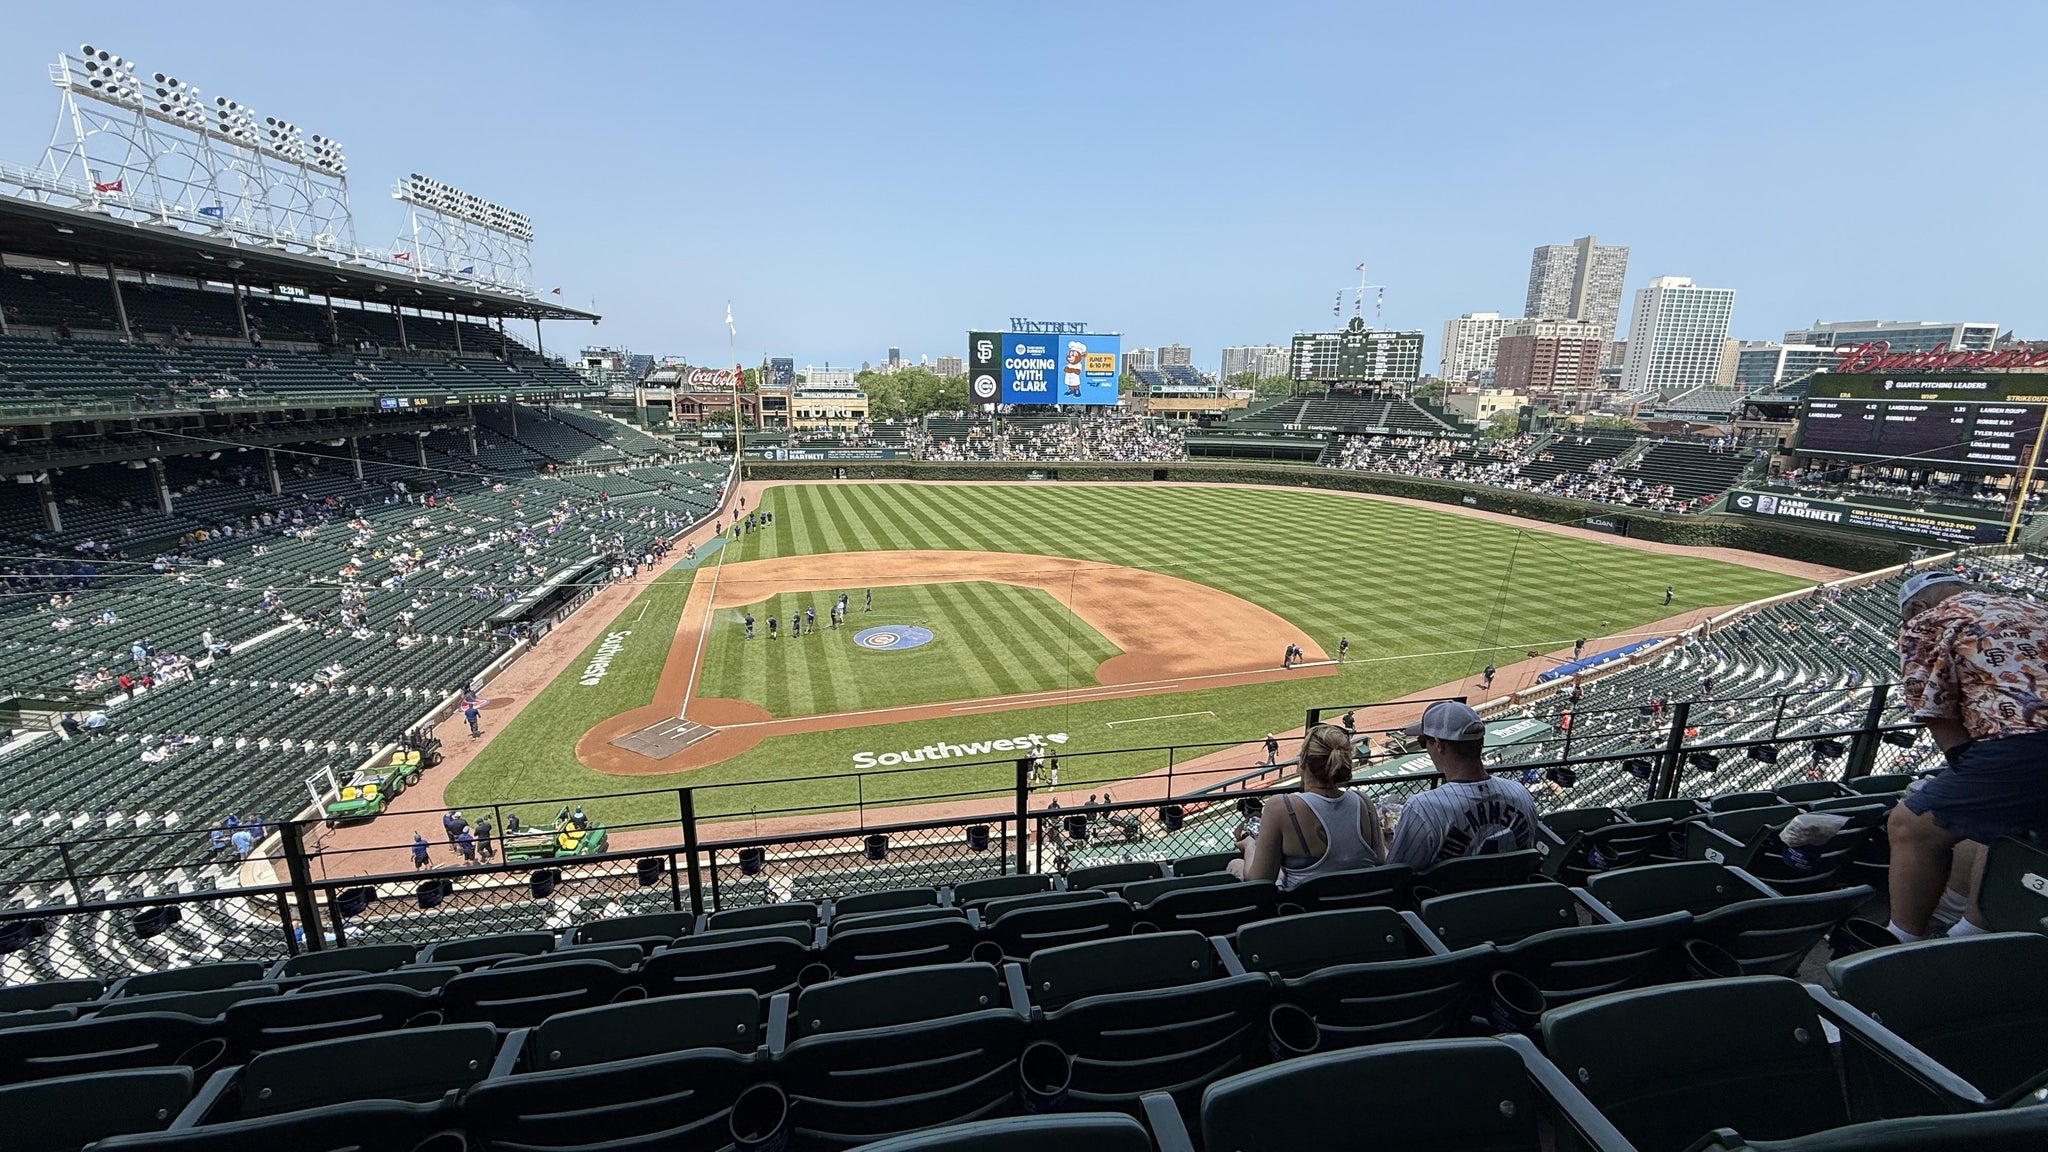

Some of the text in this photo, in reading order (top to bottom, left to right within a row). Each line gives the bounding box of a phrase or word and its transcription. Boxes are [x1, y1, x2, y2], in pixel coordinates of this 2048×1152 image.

[295, 287, 304, 297] PM
[1833, 340, 2048, 373] Budweise
[1005, 358, 1055, 369] COOKING
[688, 369, 738, 386] Coca-Cola
[1015, 370, 1043, 380] WITH
[1012, 380, 1047, 391] CLARK
[1921, 381, 1953, 389] PITCHING
[1396, 428, 1433, 436] Budweiser
[1780, 499, 1810, 509] GABBY
[1778, 505, 1842, 522] HARTNETT
[1586, 517, 1613, 527] SLOAN
[580, 630, 632, 679] Southwest
[852, 733, 1048, 769] Southwest
[1710, 851, 1718, 860] 2
[2033, 879, 2045, 890] 3
